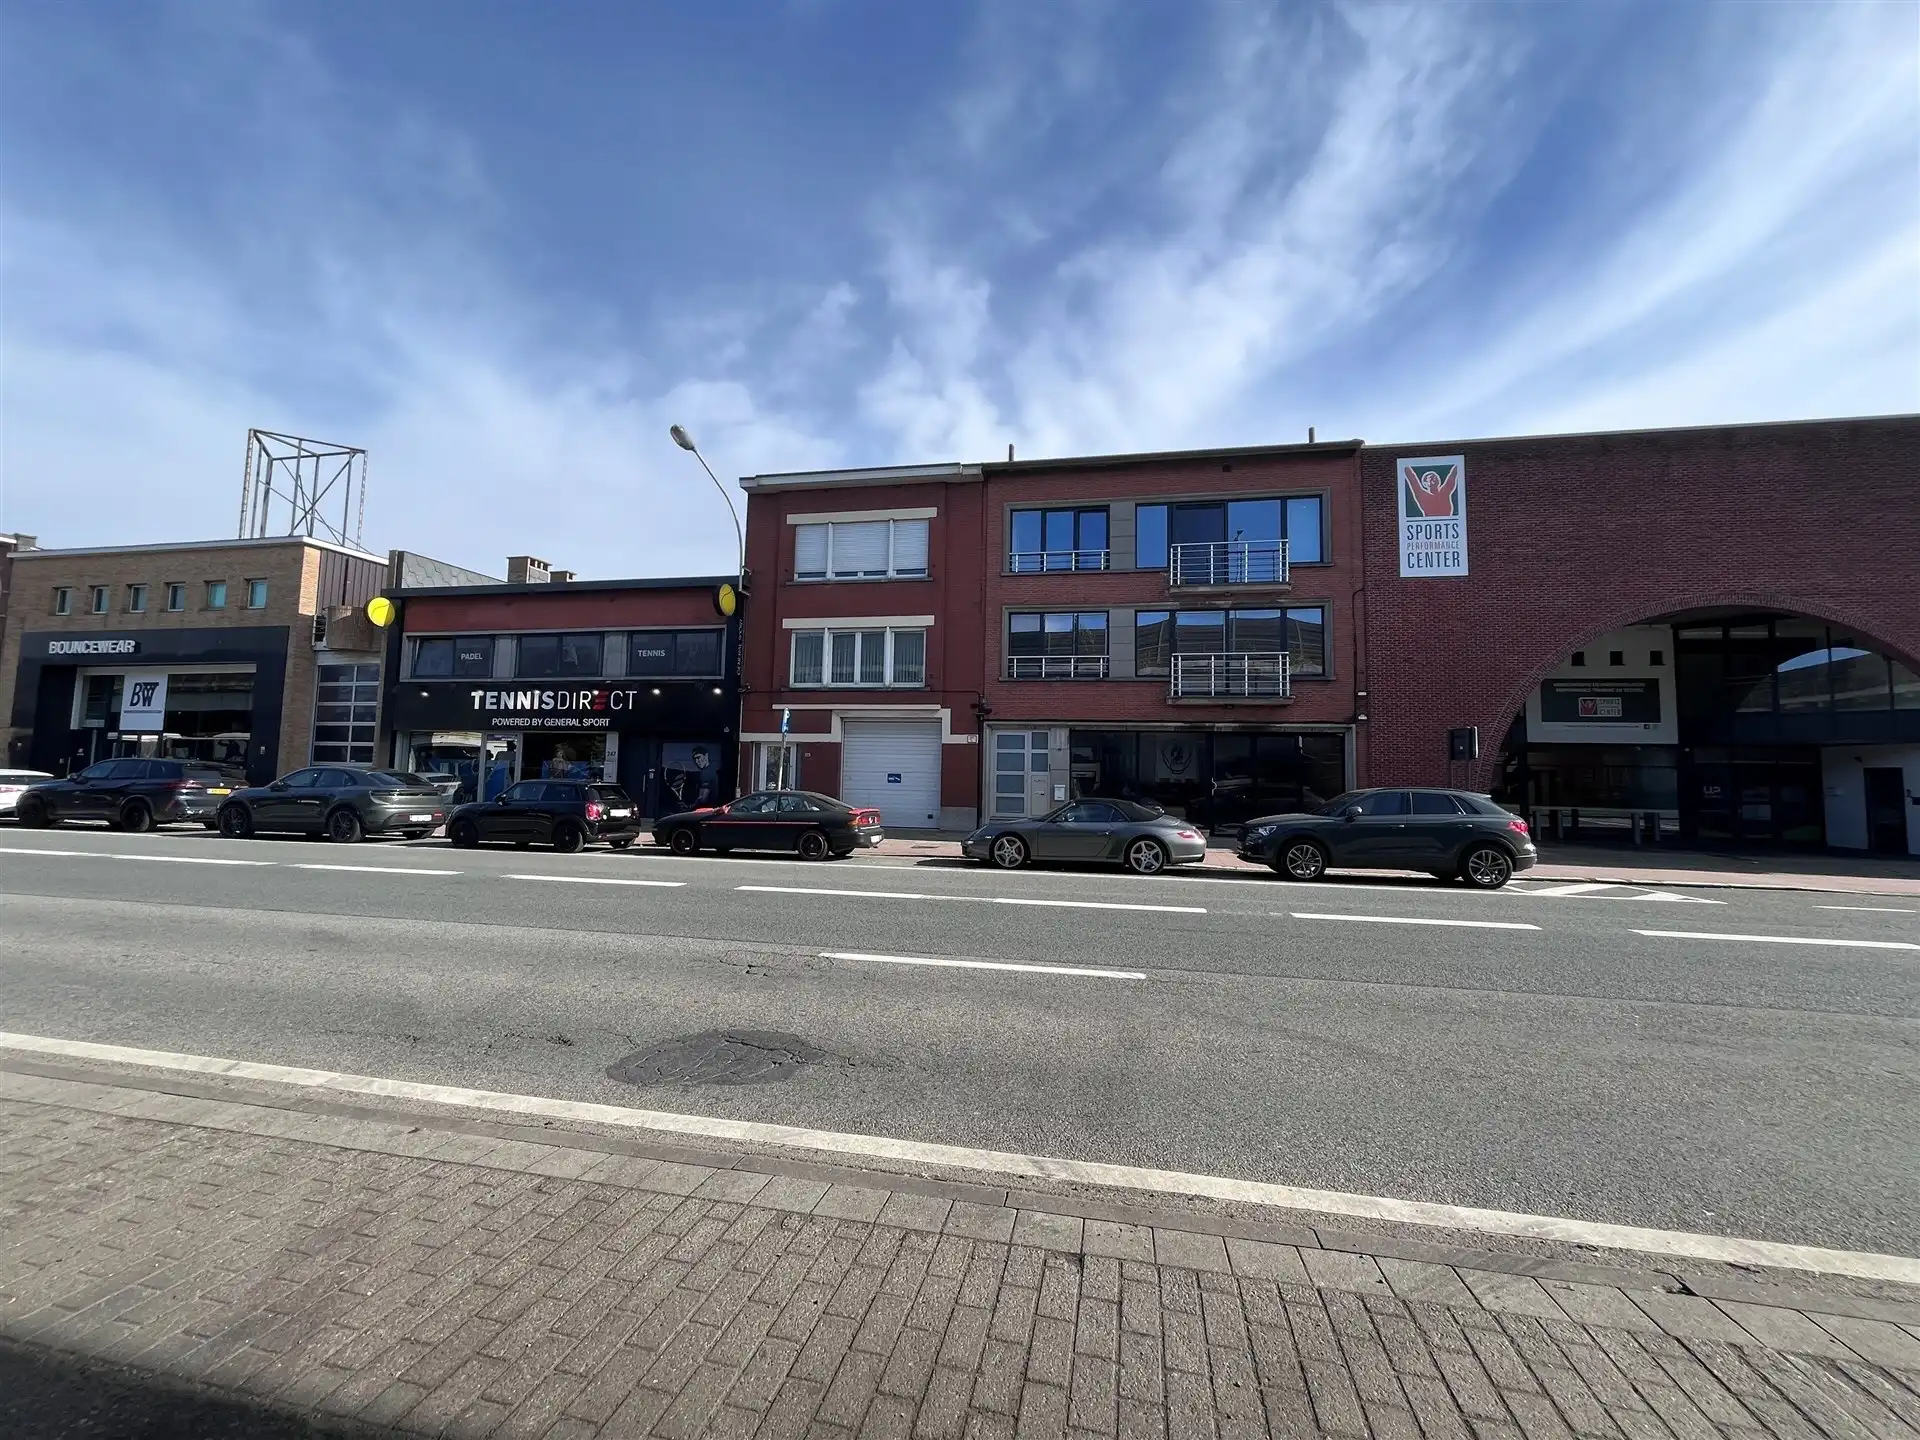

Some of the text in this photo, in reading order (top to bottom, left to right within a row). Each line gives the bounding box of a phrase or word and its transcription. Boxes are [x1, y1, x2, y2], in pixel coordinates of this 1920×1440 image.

[1407, 523, 1459, 540] SPORTS
[1406, 541, 1460, 551] PERFORMANCE
[1407, 551, 1460, 568] CENTER
[48, 640, 136, 654] BOUNCEWEAR
[638, 649, 666, 657] TENNIS
[460, 652, 483, 660] PADEL
[129, 682, 159, 707] BW
[471, 690, 638, 711] TENNISDIRECT
[492, 717, 610, 727] POWERED BY GENERAL SPORT
